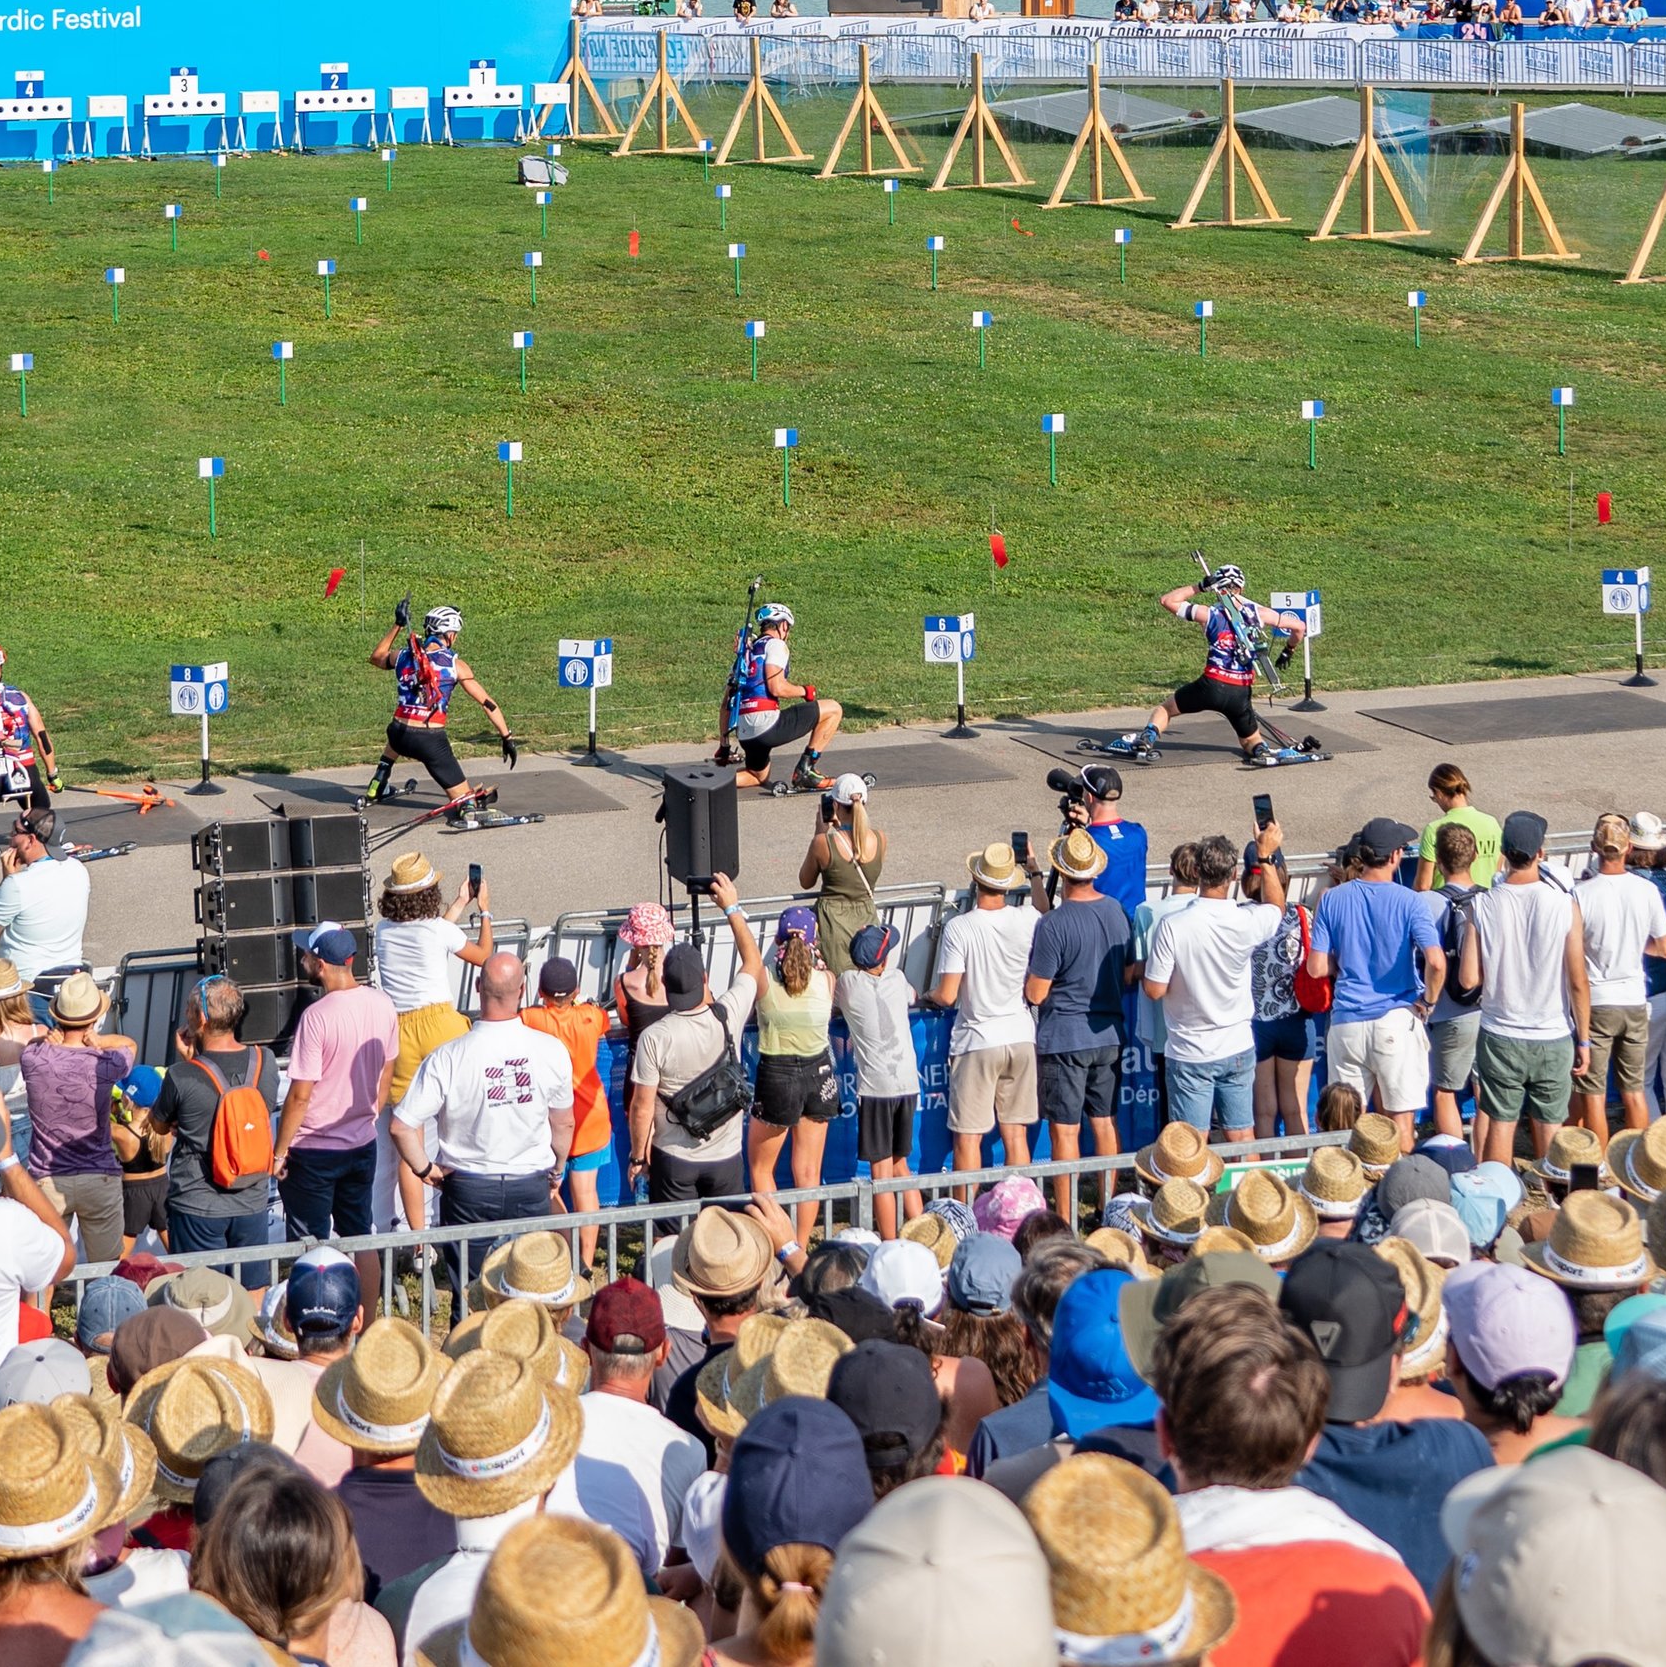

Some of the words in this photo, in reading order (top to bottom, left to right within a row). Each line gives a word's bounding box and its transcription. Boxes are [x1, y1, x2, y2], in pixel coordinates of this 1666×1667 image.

[51, 5, 141, 31] Festival
[180, 78, 189, 93] 3
[330, 74, 340, 90] 2
[480, 72, 485, 85] 1
[24, 81, 34, 98] 4
[1616, 571, 1624, 584] 4
[1285, 595, 1292, 607] 5
[938, 618, 946, 631] 6
[574, 643, 580, 655] 7
[184, 667, 191, 681] 8
[471, 1448, 525, 1473] ekosport
[56, 1496, 98, 1534] ekosport
